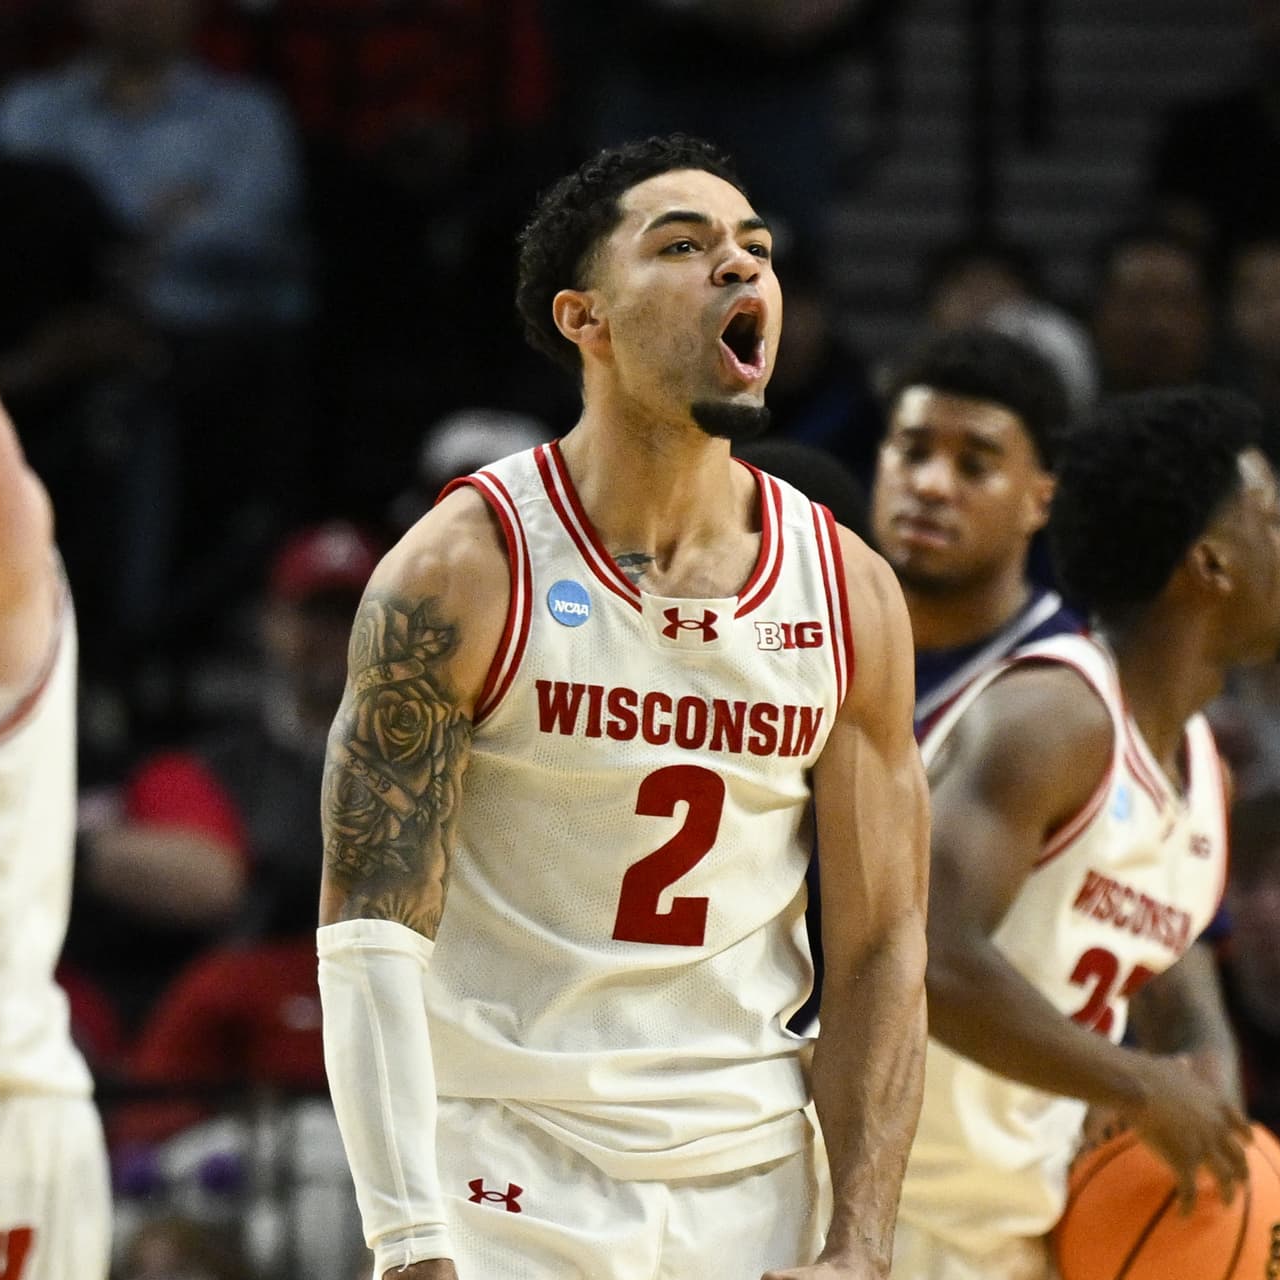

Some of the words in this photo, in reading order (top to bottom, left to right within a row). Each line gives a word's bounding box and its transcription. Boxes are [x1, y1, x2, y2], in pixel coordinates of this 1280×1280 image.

[554, 599, 589, 617] NCAA
[535, 680, 824, 758] WISCONSIN
[612, 764, 726, 946] 2
